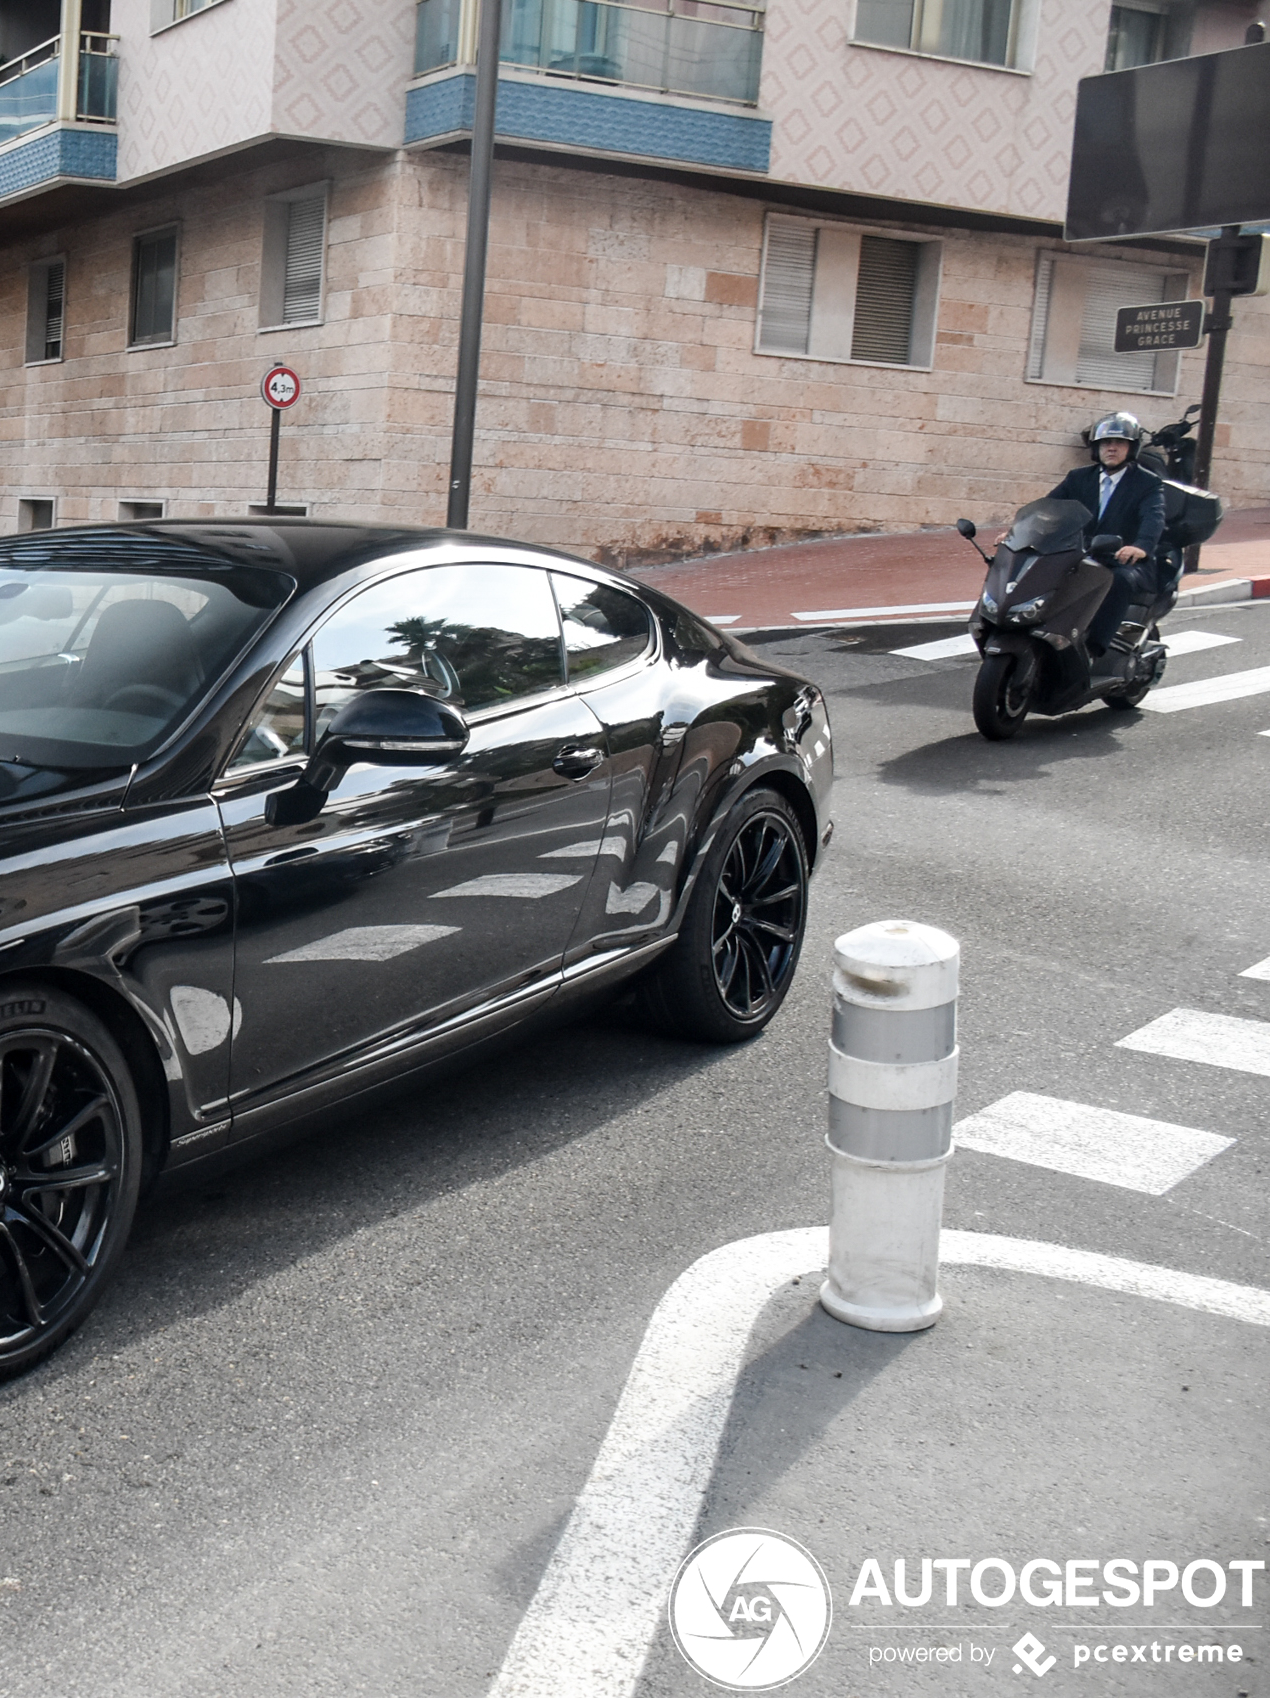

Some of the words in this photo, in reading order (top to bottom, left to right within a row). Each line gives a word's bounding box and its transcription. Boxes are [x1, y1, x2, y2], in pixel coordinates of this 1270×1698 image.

[1136, 307, 1181, 321] AVENUE
[1125, 320, 1190, 334] PRINCESSE
[1137, 333, 1176, 346] GRACE
